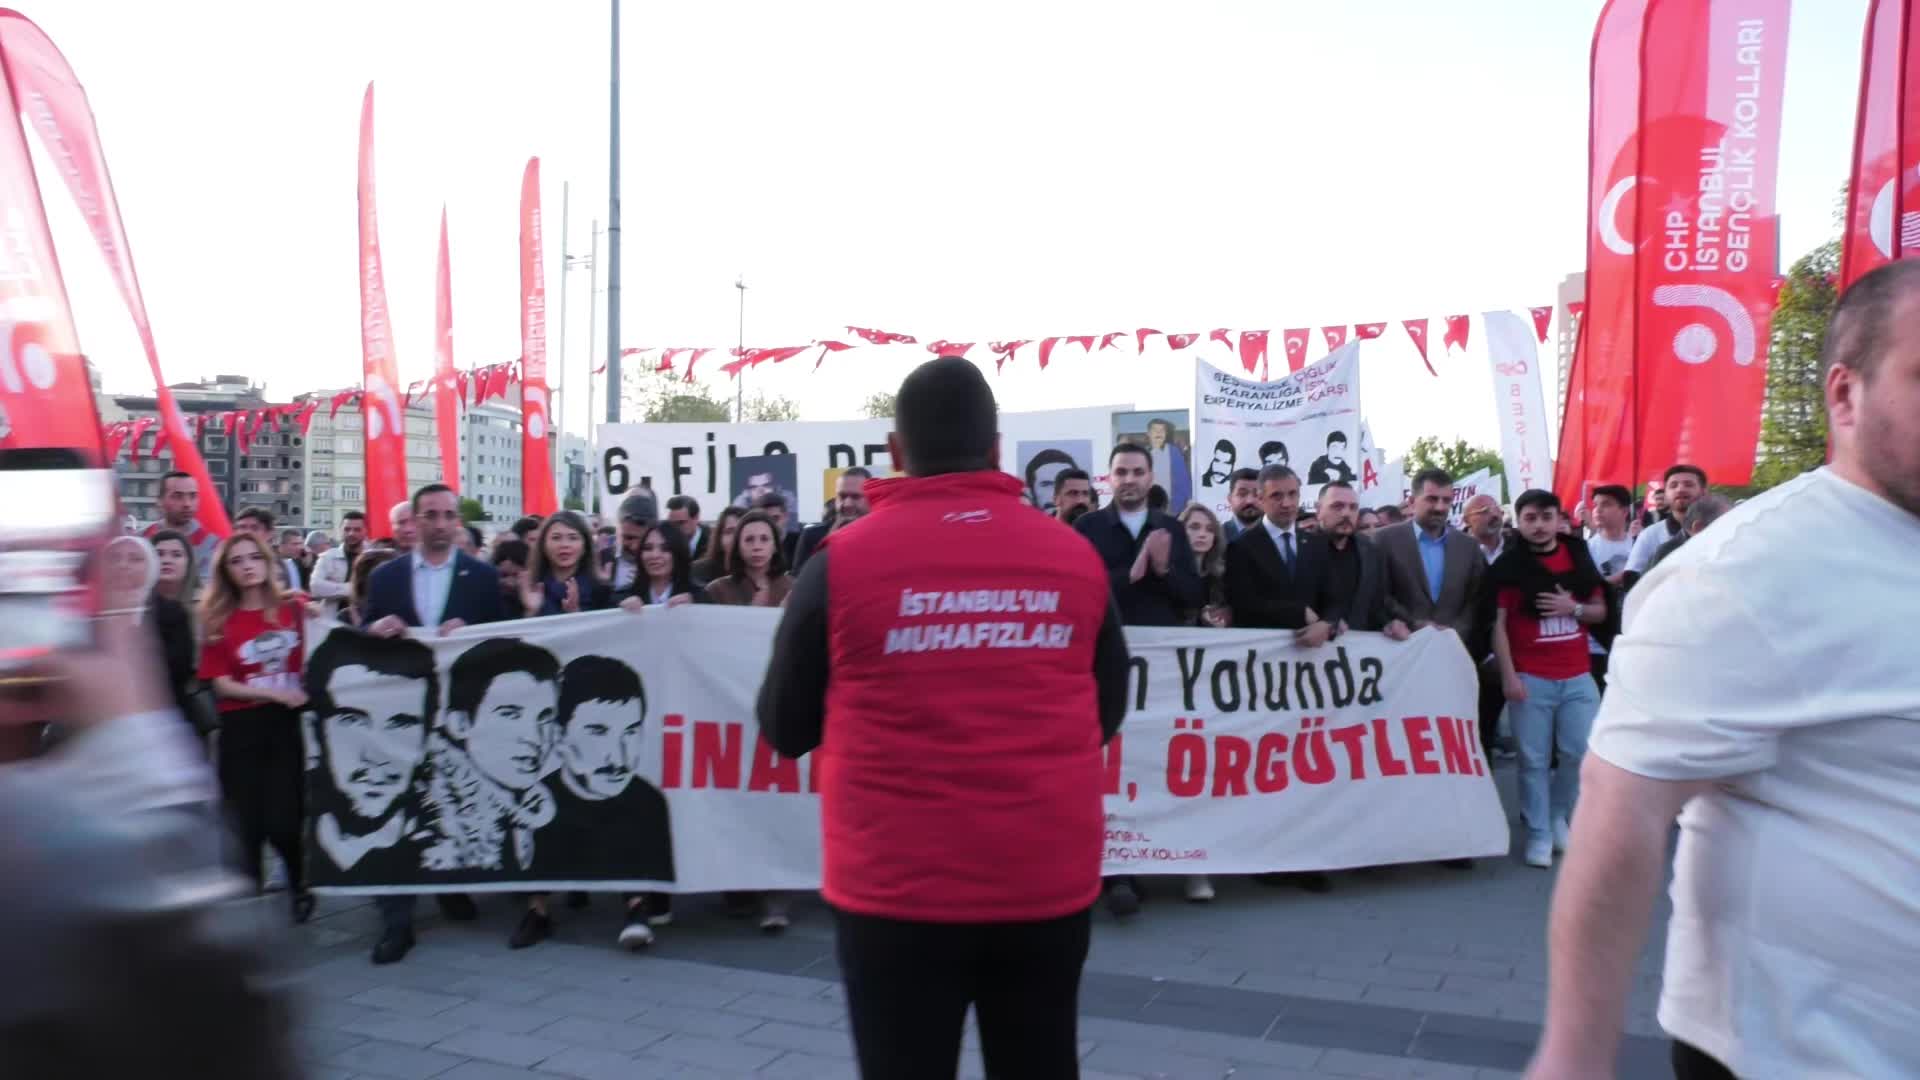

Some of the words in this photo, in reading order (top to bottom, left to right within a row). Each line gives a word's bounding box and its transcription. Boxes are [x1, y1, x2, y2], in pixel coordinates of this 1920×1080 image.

[1734, 19, 1763, 139] KOLLARI
[1664, 211, 1689, 272] CHP
[1726, 148, 1757, 272] GENÇLİK
[898, 588, 1061, 617] İSTANBUL'UN
[883, 622, 1074, 655] MUHAFIZLARI
[1176, 646, 1384, 713] Yolunda
[1165, 716, 1484, 798] ÖRGÜTLEN!
